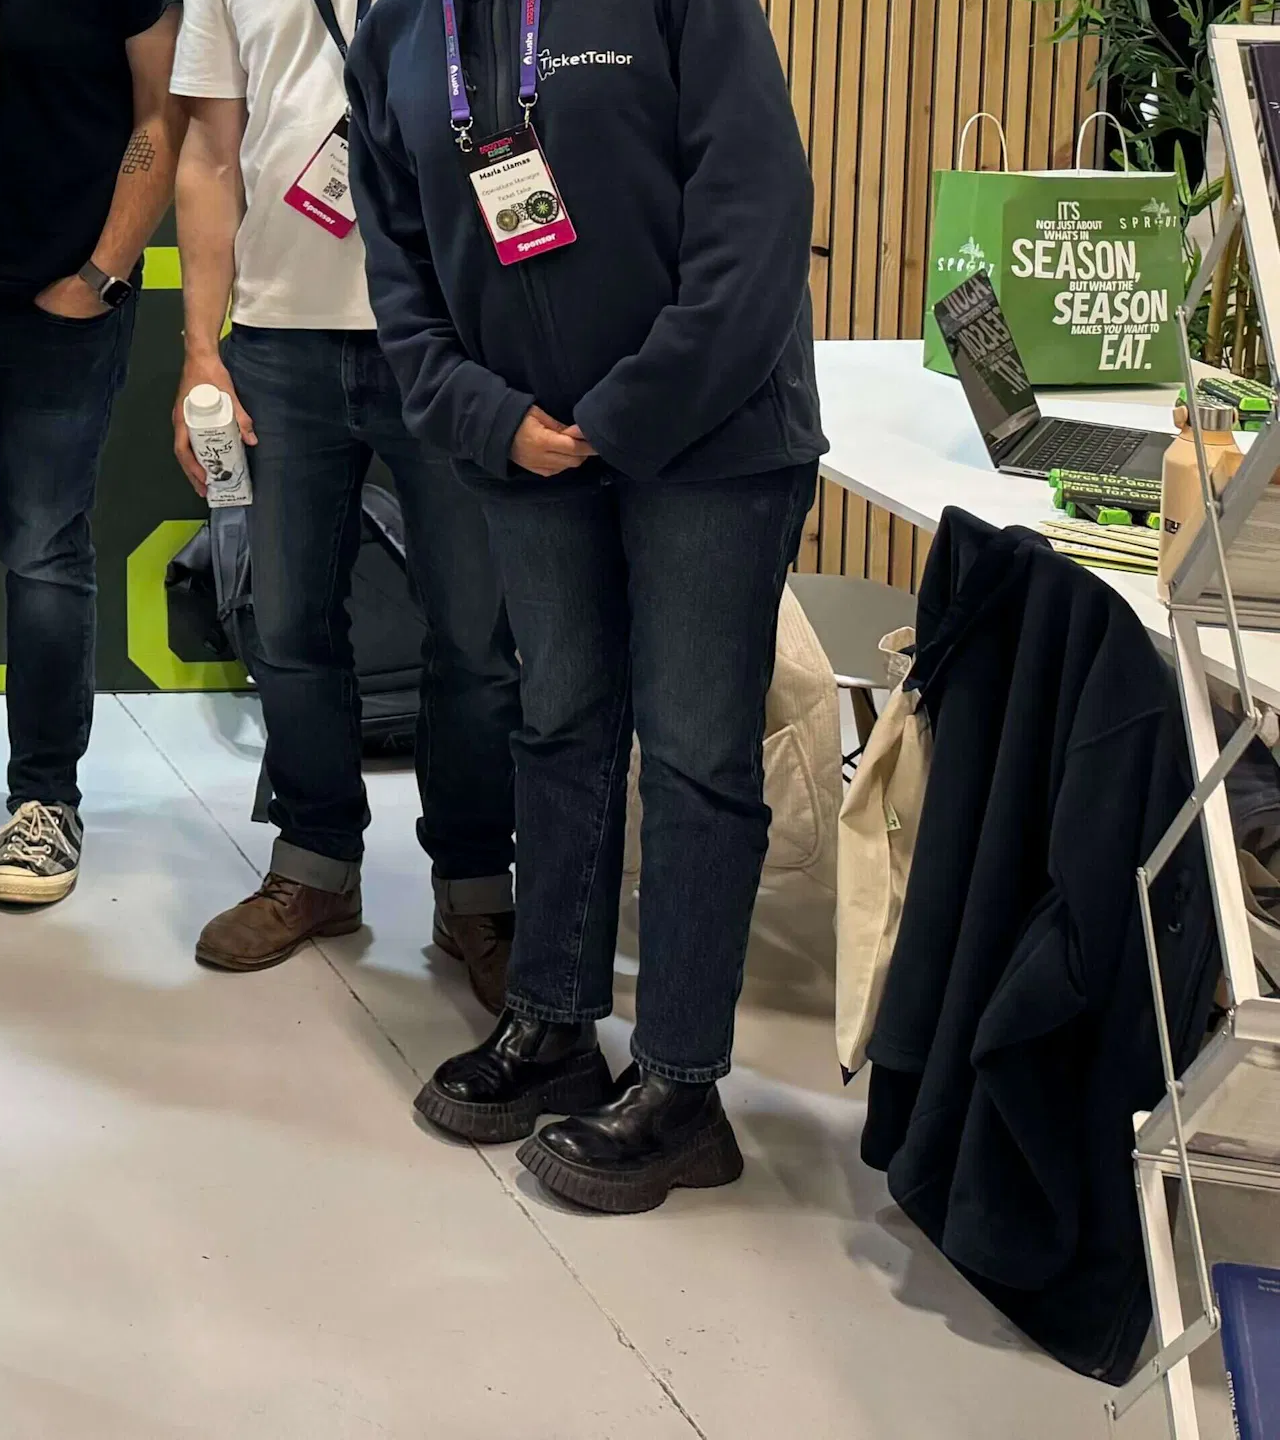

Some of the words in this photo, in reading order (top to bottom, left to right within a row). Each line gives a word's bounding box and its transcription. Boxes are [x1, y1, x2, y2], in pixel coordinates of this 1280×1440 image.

[541, 50, 633, 69] TicketTailor
[1058, 201, 1080, 220] IT'S
[1036, 220, 1056, 229] NOT
[1057, 220, 1076, 229] JUST
[1076, 221, 1102, 229] ABOUT
[517, 233, 557, 251] Sponsor
[1044, 231, 1079, 240] WHAT'S
[1080, 231, 1089, 240] IN
[1011, 239, 1141, 282] SEASON,
[1069, 281, 1088, 291] BUT
[1089, 281, 1118, 290] WHAT
[1117, 280, 1134, 290] THE
[1052, 289, 1168, 325] SEASON
[1071, 325, 1102, 334] MAKES
[1104, 324, 1122, 334] YOU
[1123, 324, 1150, 334] WANT
[1150, 323, 1159, 333] TO
[1098, 334, 1152, 370] EAT.
[1060, 470, 1100, 481] Force
[1103, 476, 1124, 484] for
[1063, 483, 1102, 494] Force
[1130, 491, 1162, 500] Goo
